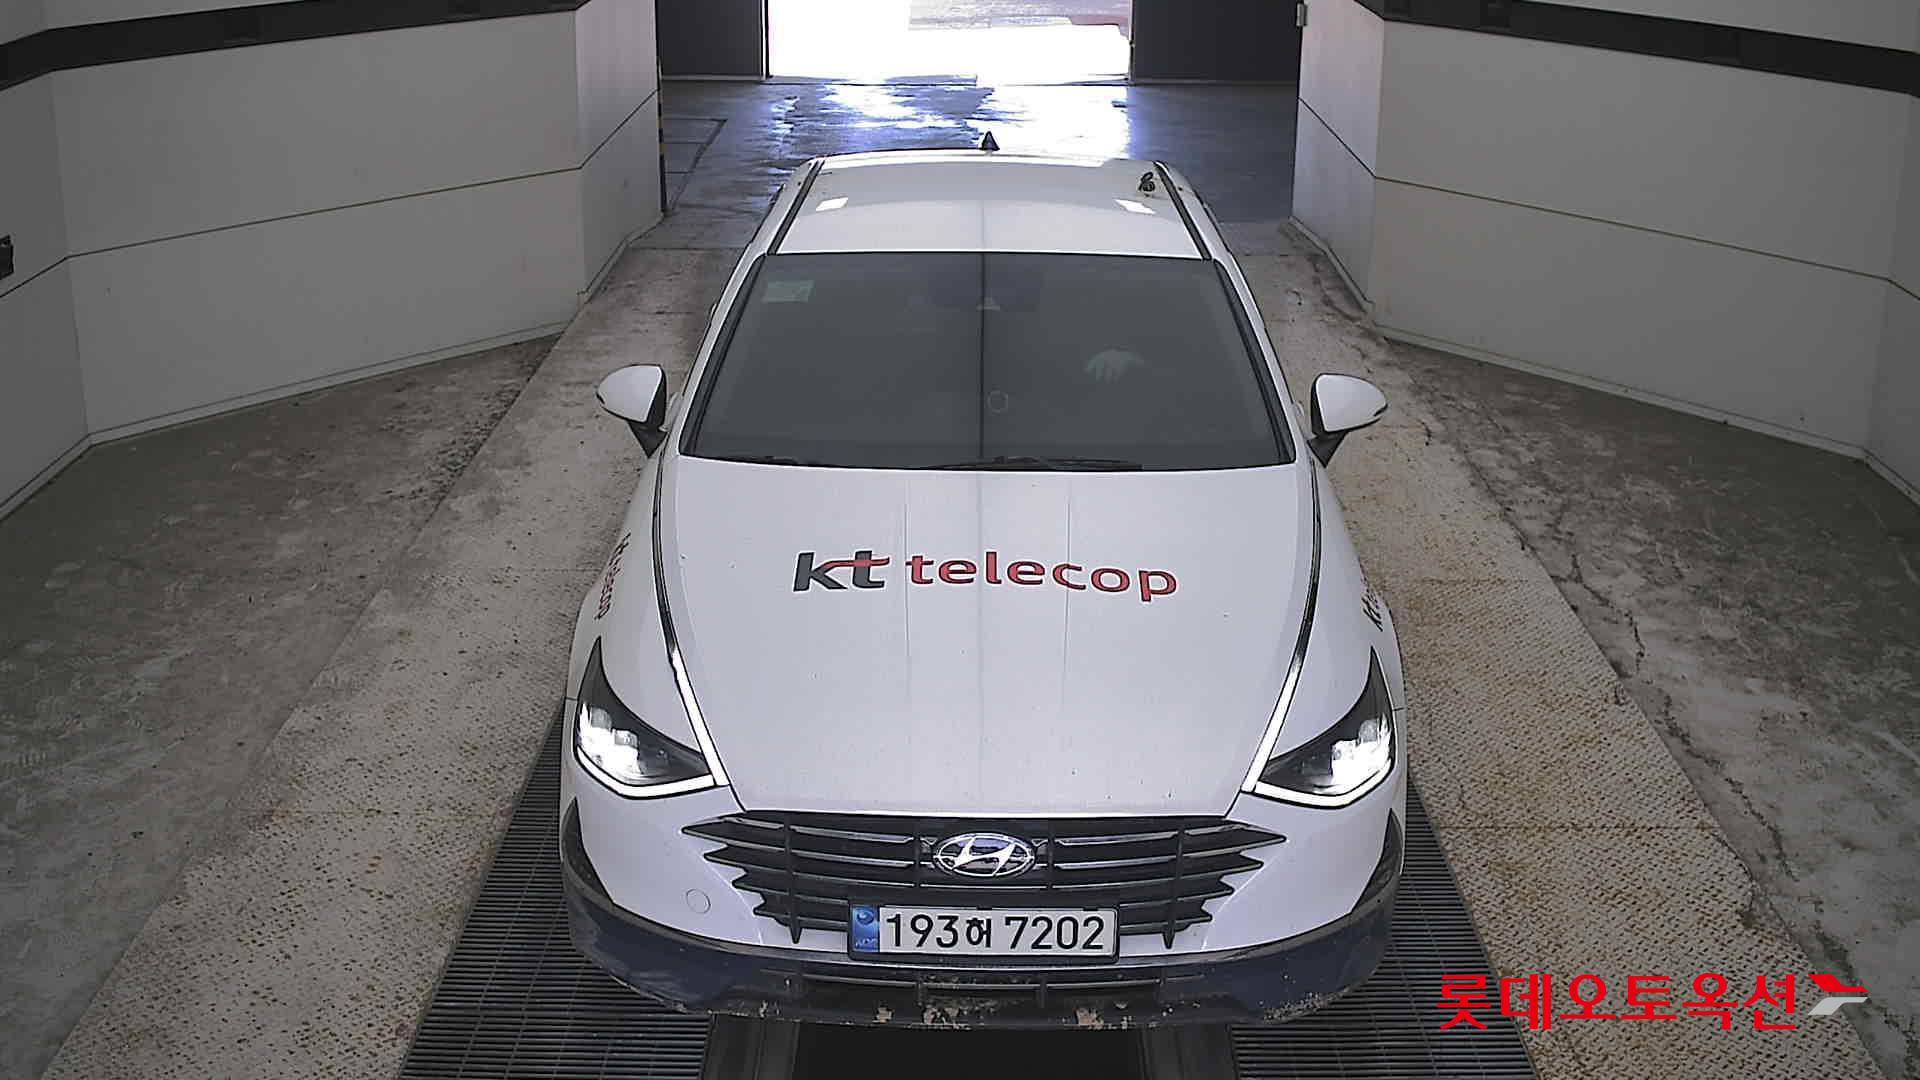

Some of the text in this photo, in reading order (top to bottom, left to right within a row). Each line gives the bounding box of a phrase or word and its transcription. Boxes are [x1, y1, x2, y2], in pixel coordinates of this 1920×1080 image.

[793, 550, 1177, 602] kt telecop
[886, 913, 1105, 950] 193허 7202
